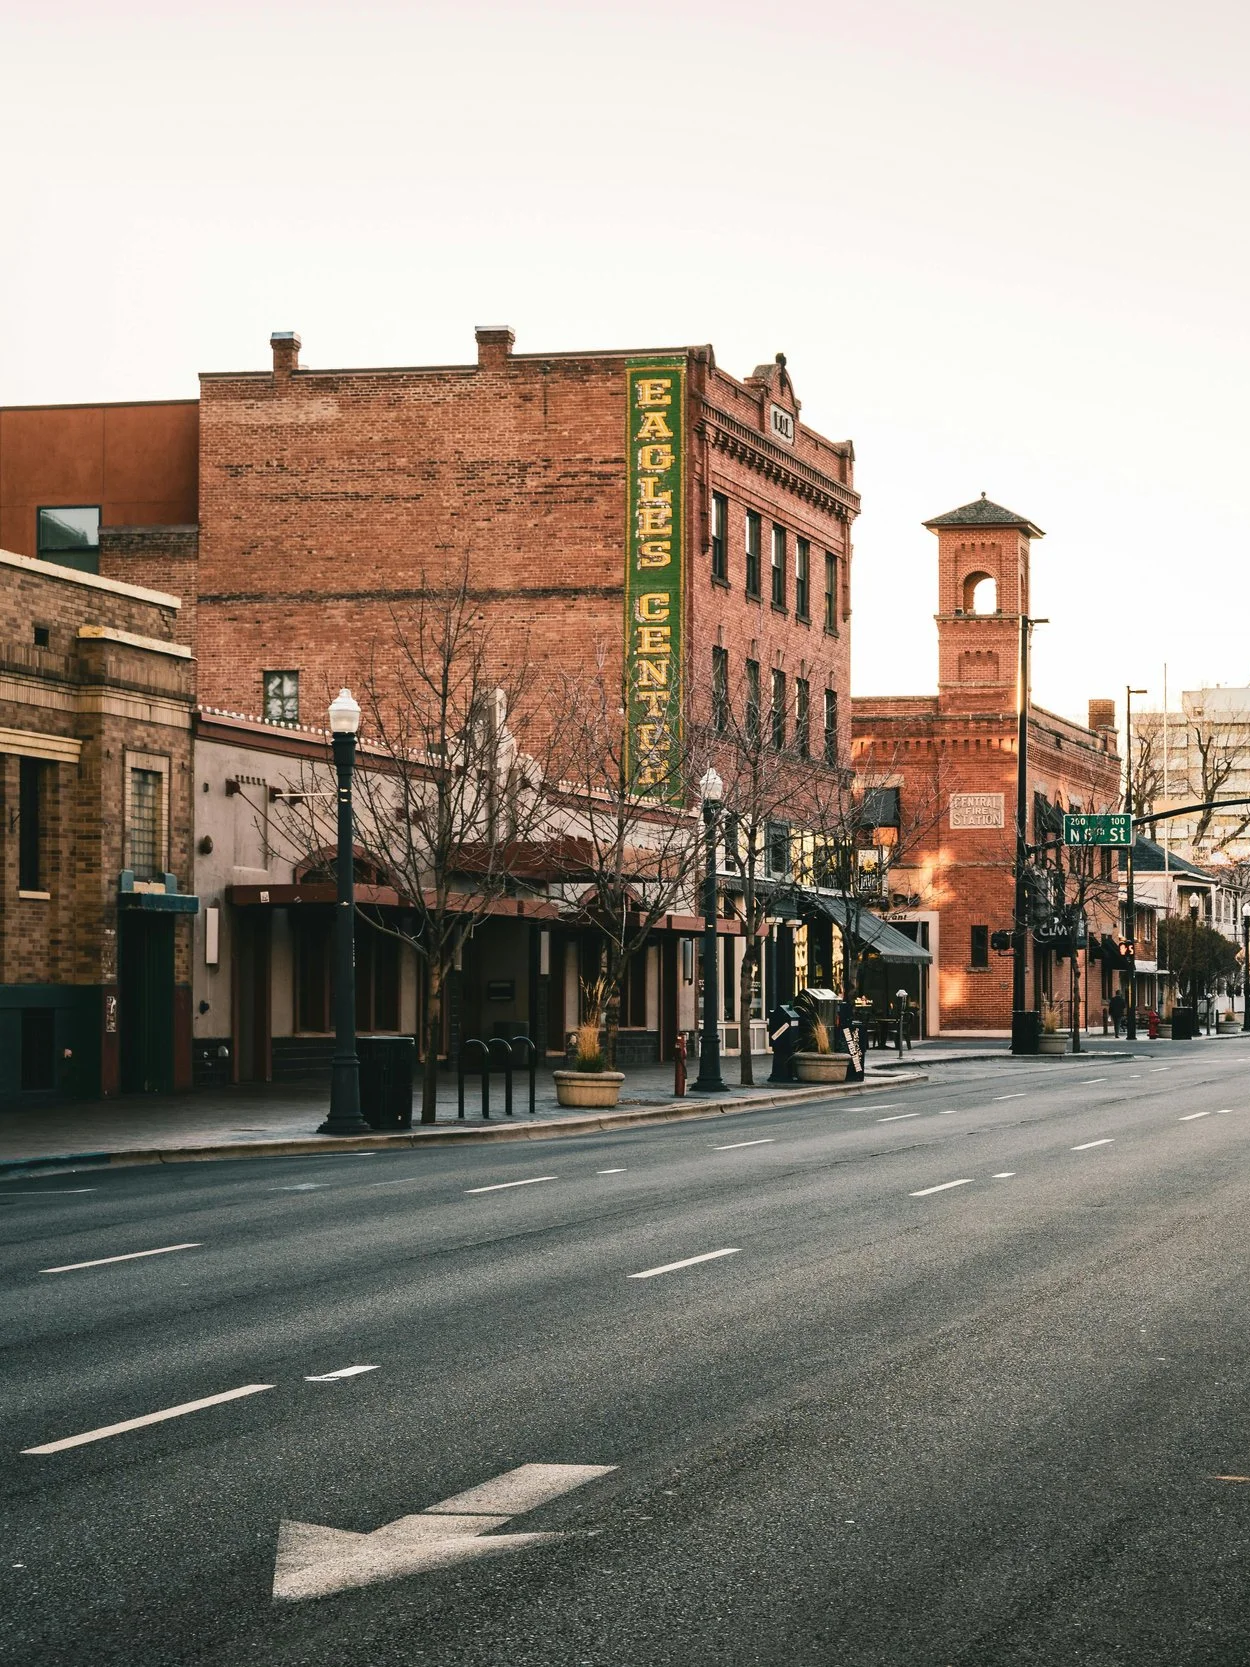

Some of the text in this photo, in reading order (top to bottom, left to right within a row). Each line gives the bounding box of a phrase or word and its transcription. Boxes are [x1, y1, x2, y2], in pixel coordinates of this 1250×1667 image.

[637, 378, 675, 785] EAGLES CENTER
[953, 797, 1000, 810] CENTRAL
[953, 812, 1001, 826] STATION
[1070, 829, 1080, 842] N
[1110, 828, 1126, 842] St
